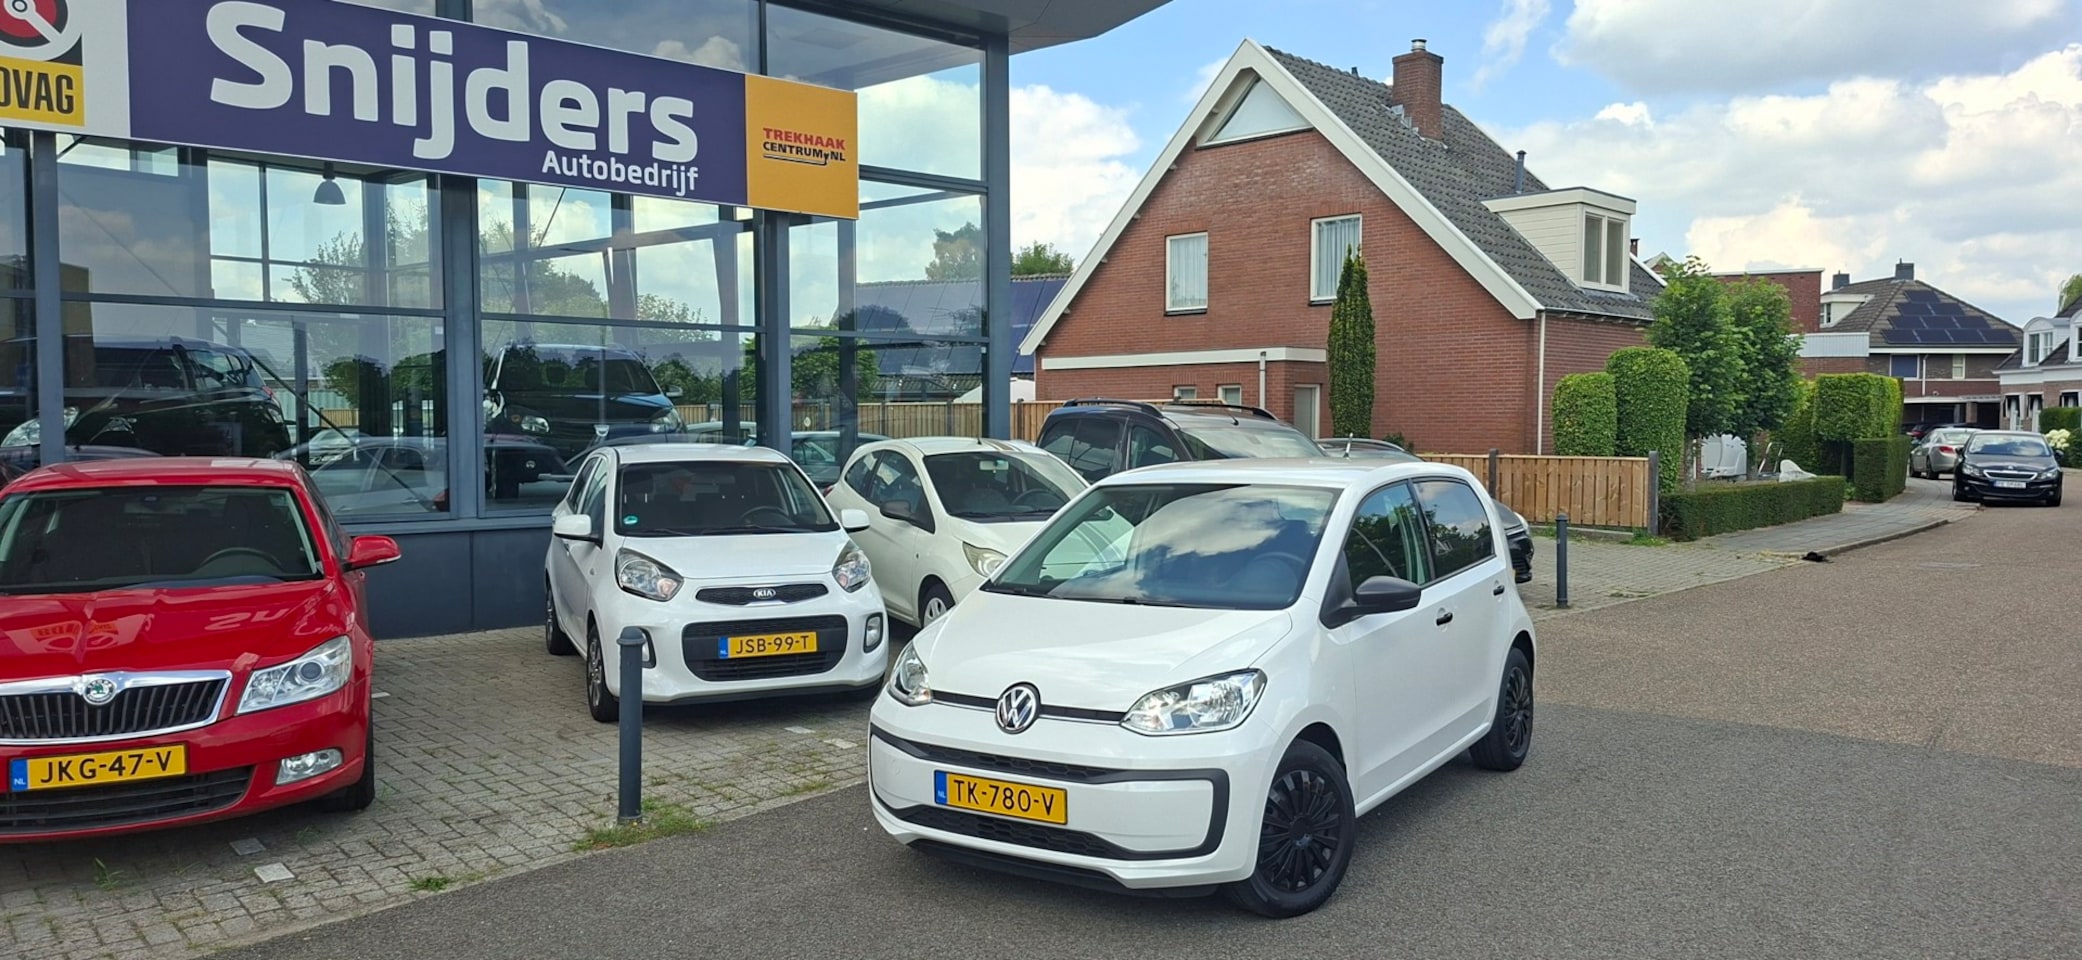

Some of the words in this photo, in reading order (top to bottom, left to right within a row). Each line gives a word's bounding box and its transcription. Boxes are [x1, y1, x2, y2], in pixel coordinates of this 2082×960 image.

[205, 1, 698, 163] Snijders
[763, 127, 846, 150] TREKHAAK
[541, 150, 698, 196] Autobedrijf
[736, 635, 809, 654] JSB-99-T
[14, 777, 26, 786] NL
[40, 750, 172, 783] JKG-47-V
[937, 789, 947, 799] NL
[953, 779, 1055, 816] TK-780-V
